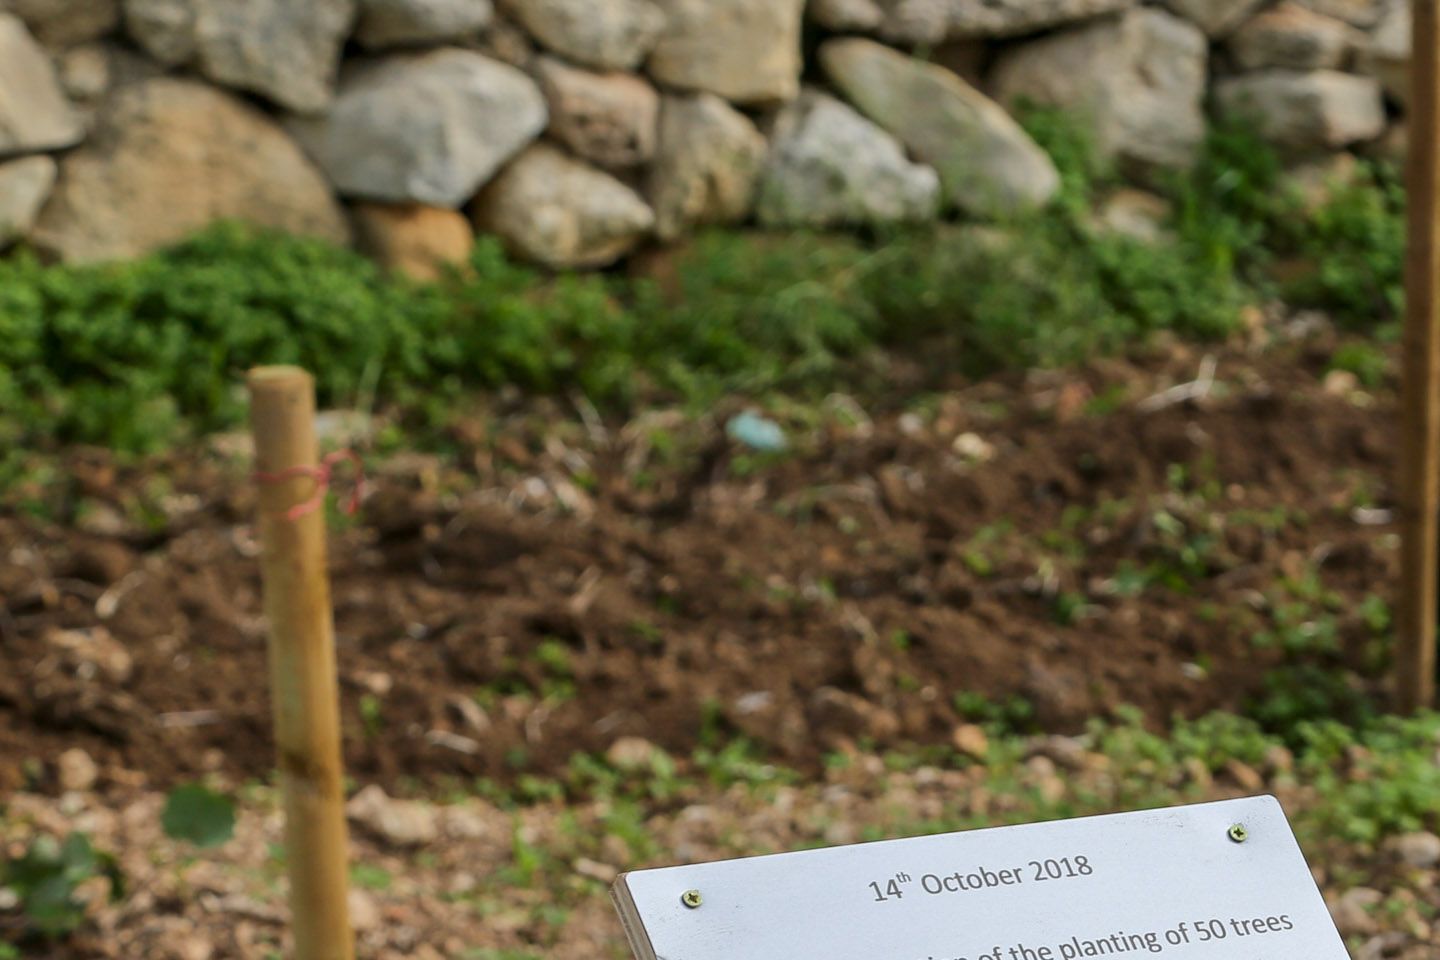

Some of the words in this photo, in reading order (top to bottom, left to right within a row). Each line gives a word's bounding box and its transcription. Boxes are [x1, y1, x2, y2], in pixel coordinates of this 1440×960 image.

[868, 871, 912, 902] 14th
[920, 866, 1023, 895] October
[1027, 855, 1094, 882] 2018
[1164, 921, 1191, 946] of
[1193, 918, 1227, 942] 50
[1229, 914, 1294, 937] trees
